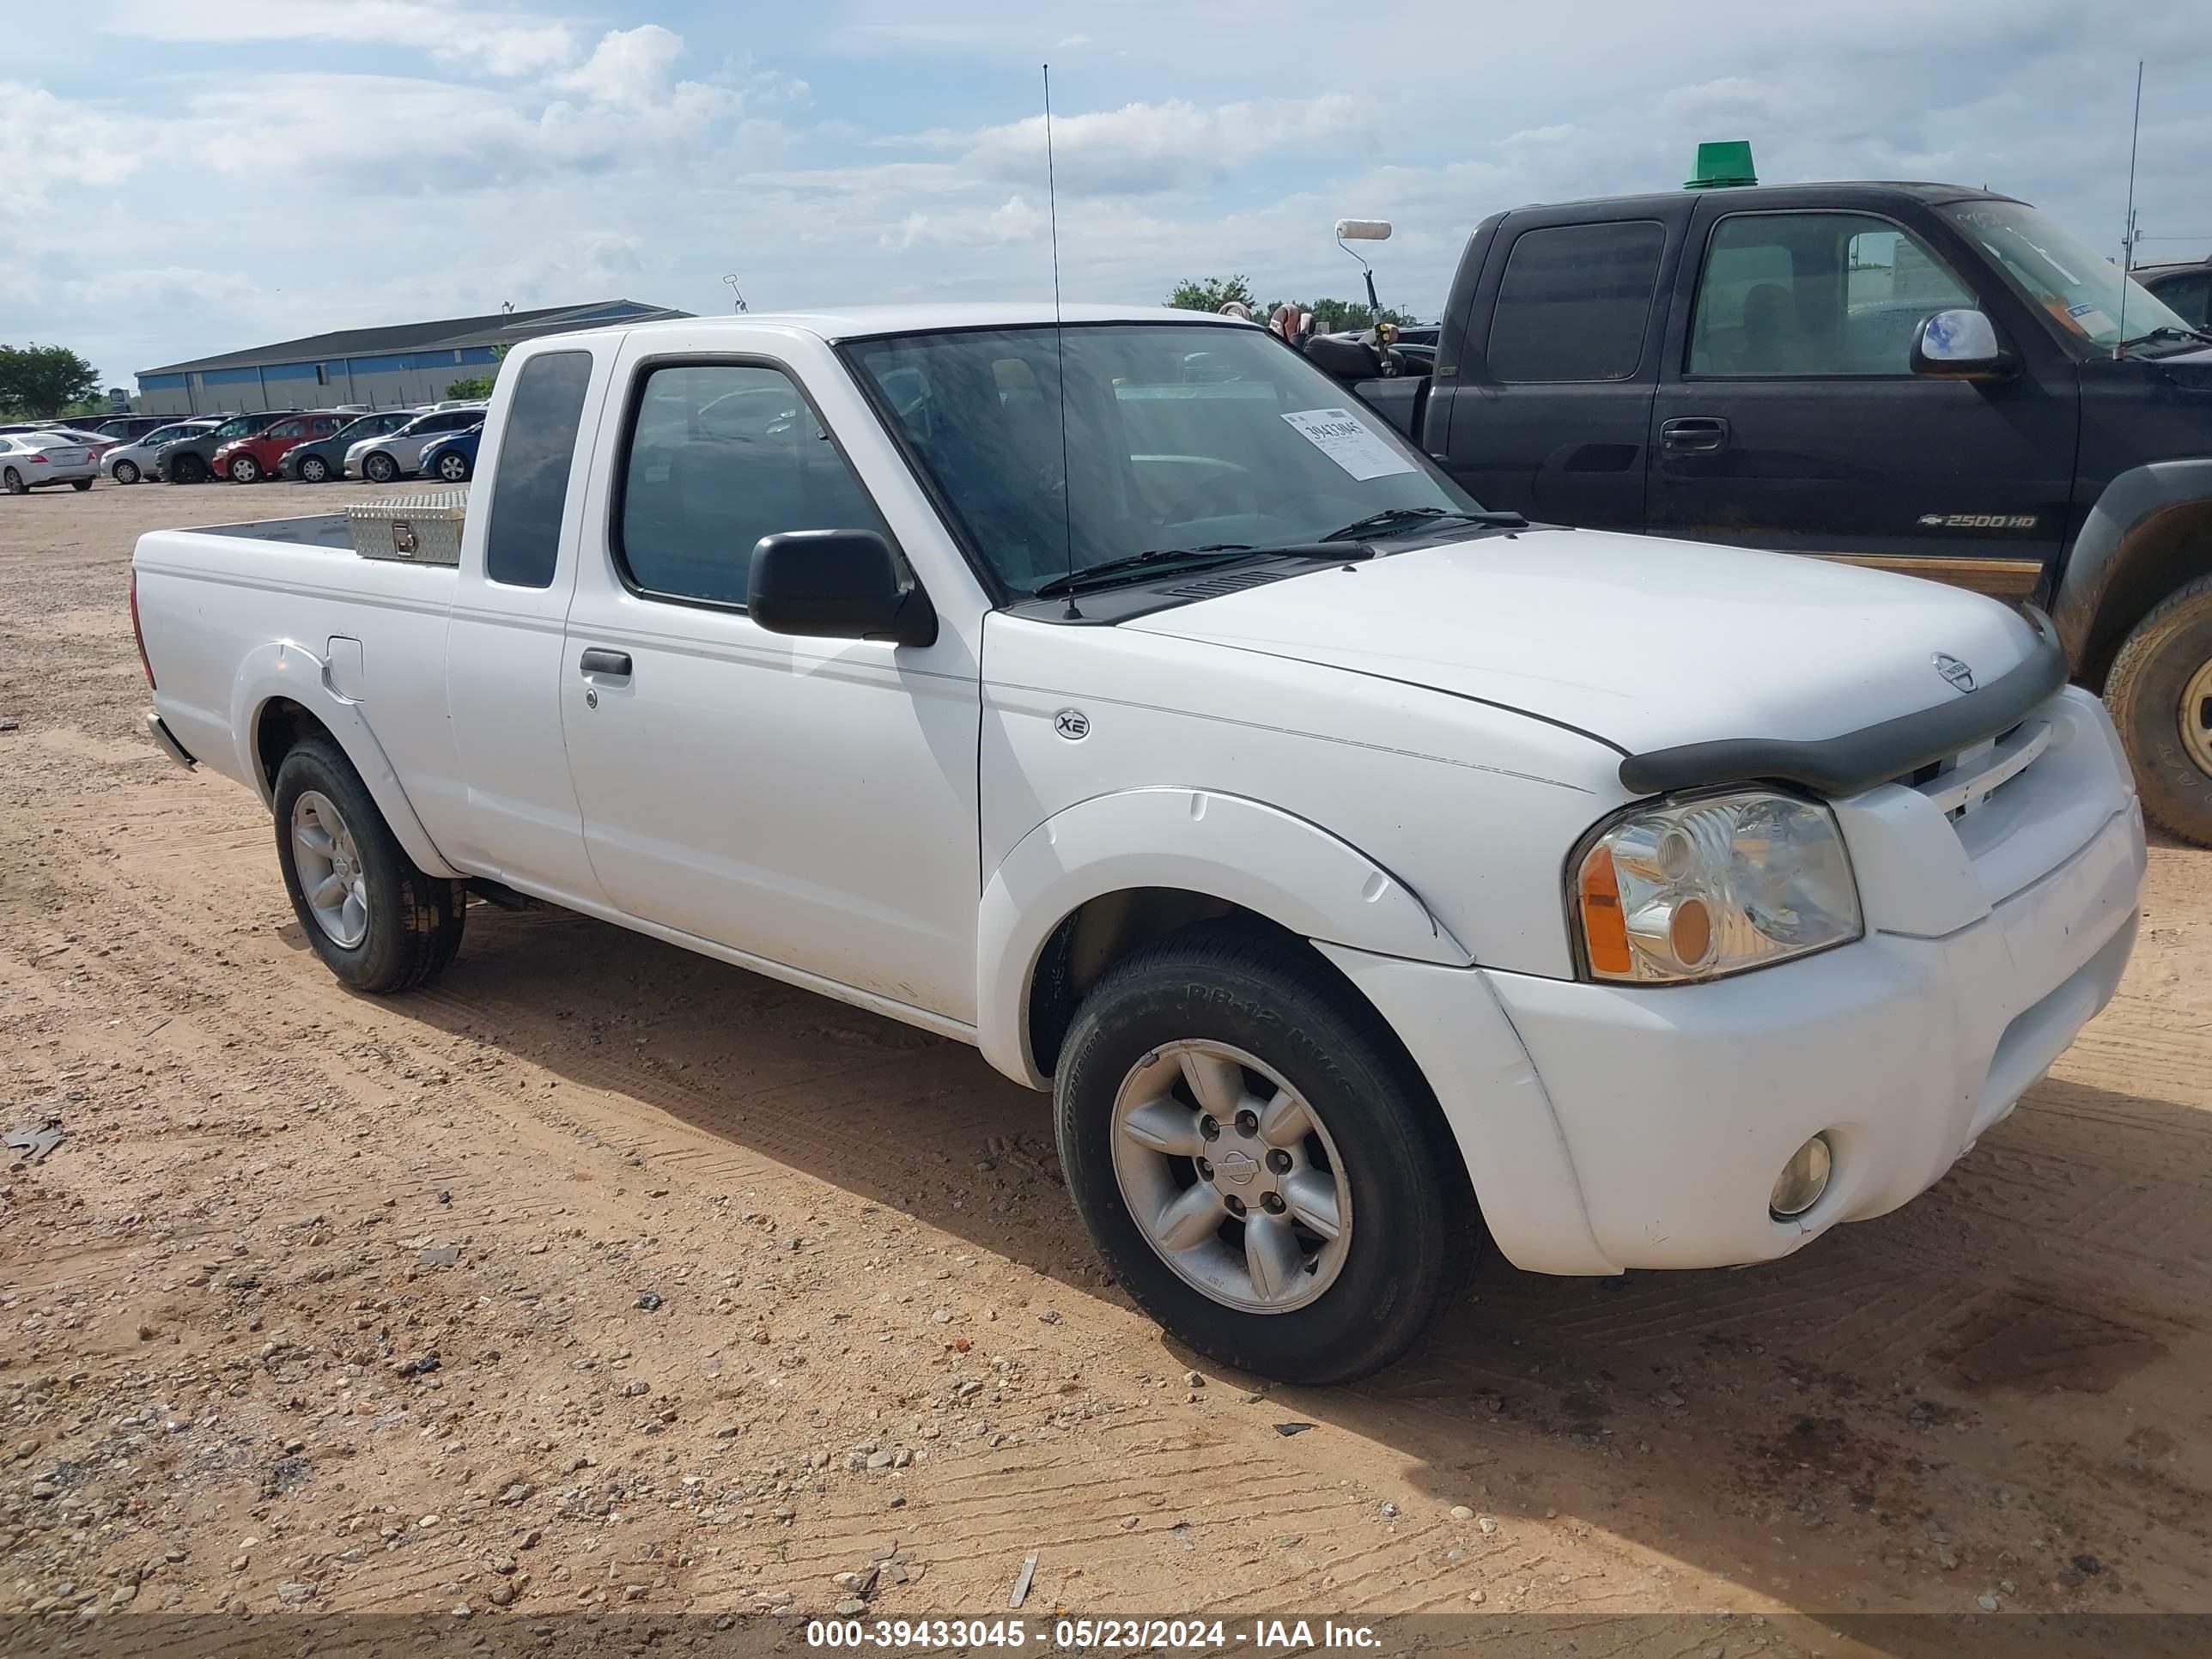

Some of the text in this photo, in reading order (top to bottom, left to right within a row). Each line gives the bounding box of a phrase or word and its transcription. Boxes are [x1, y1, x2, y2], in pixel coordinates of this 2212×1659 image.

[1305, 422, 1364, 440] 39433045
[1945, 514, 2036, 527] 2500 HD
[1058, 716, 1086, 735] XE
